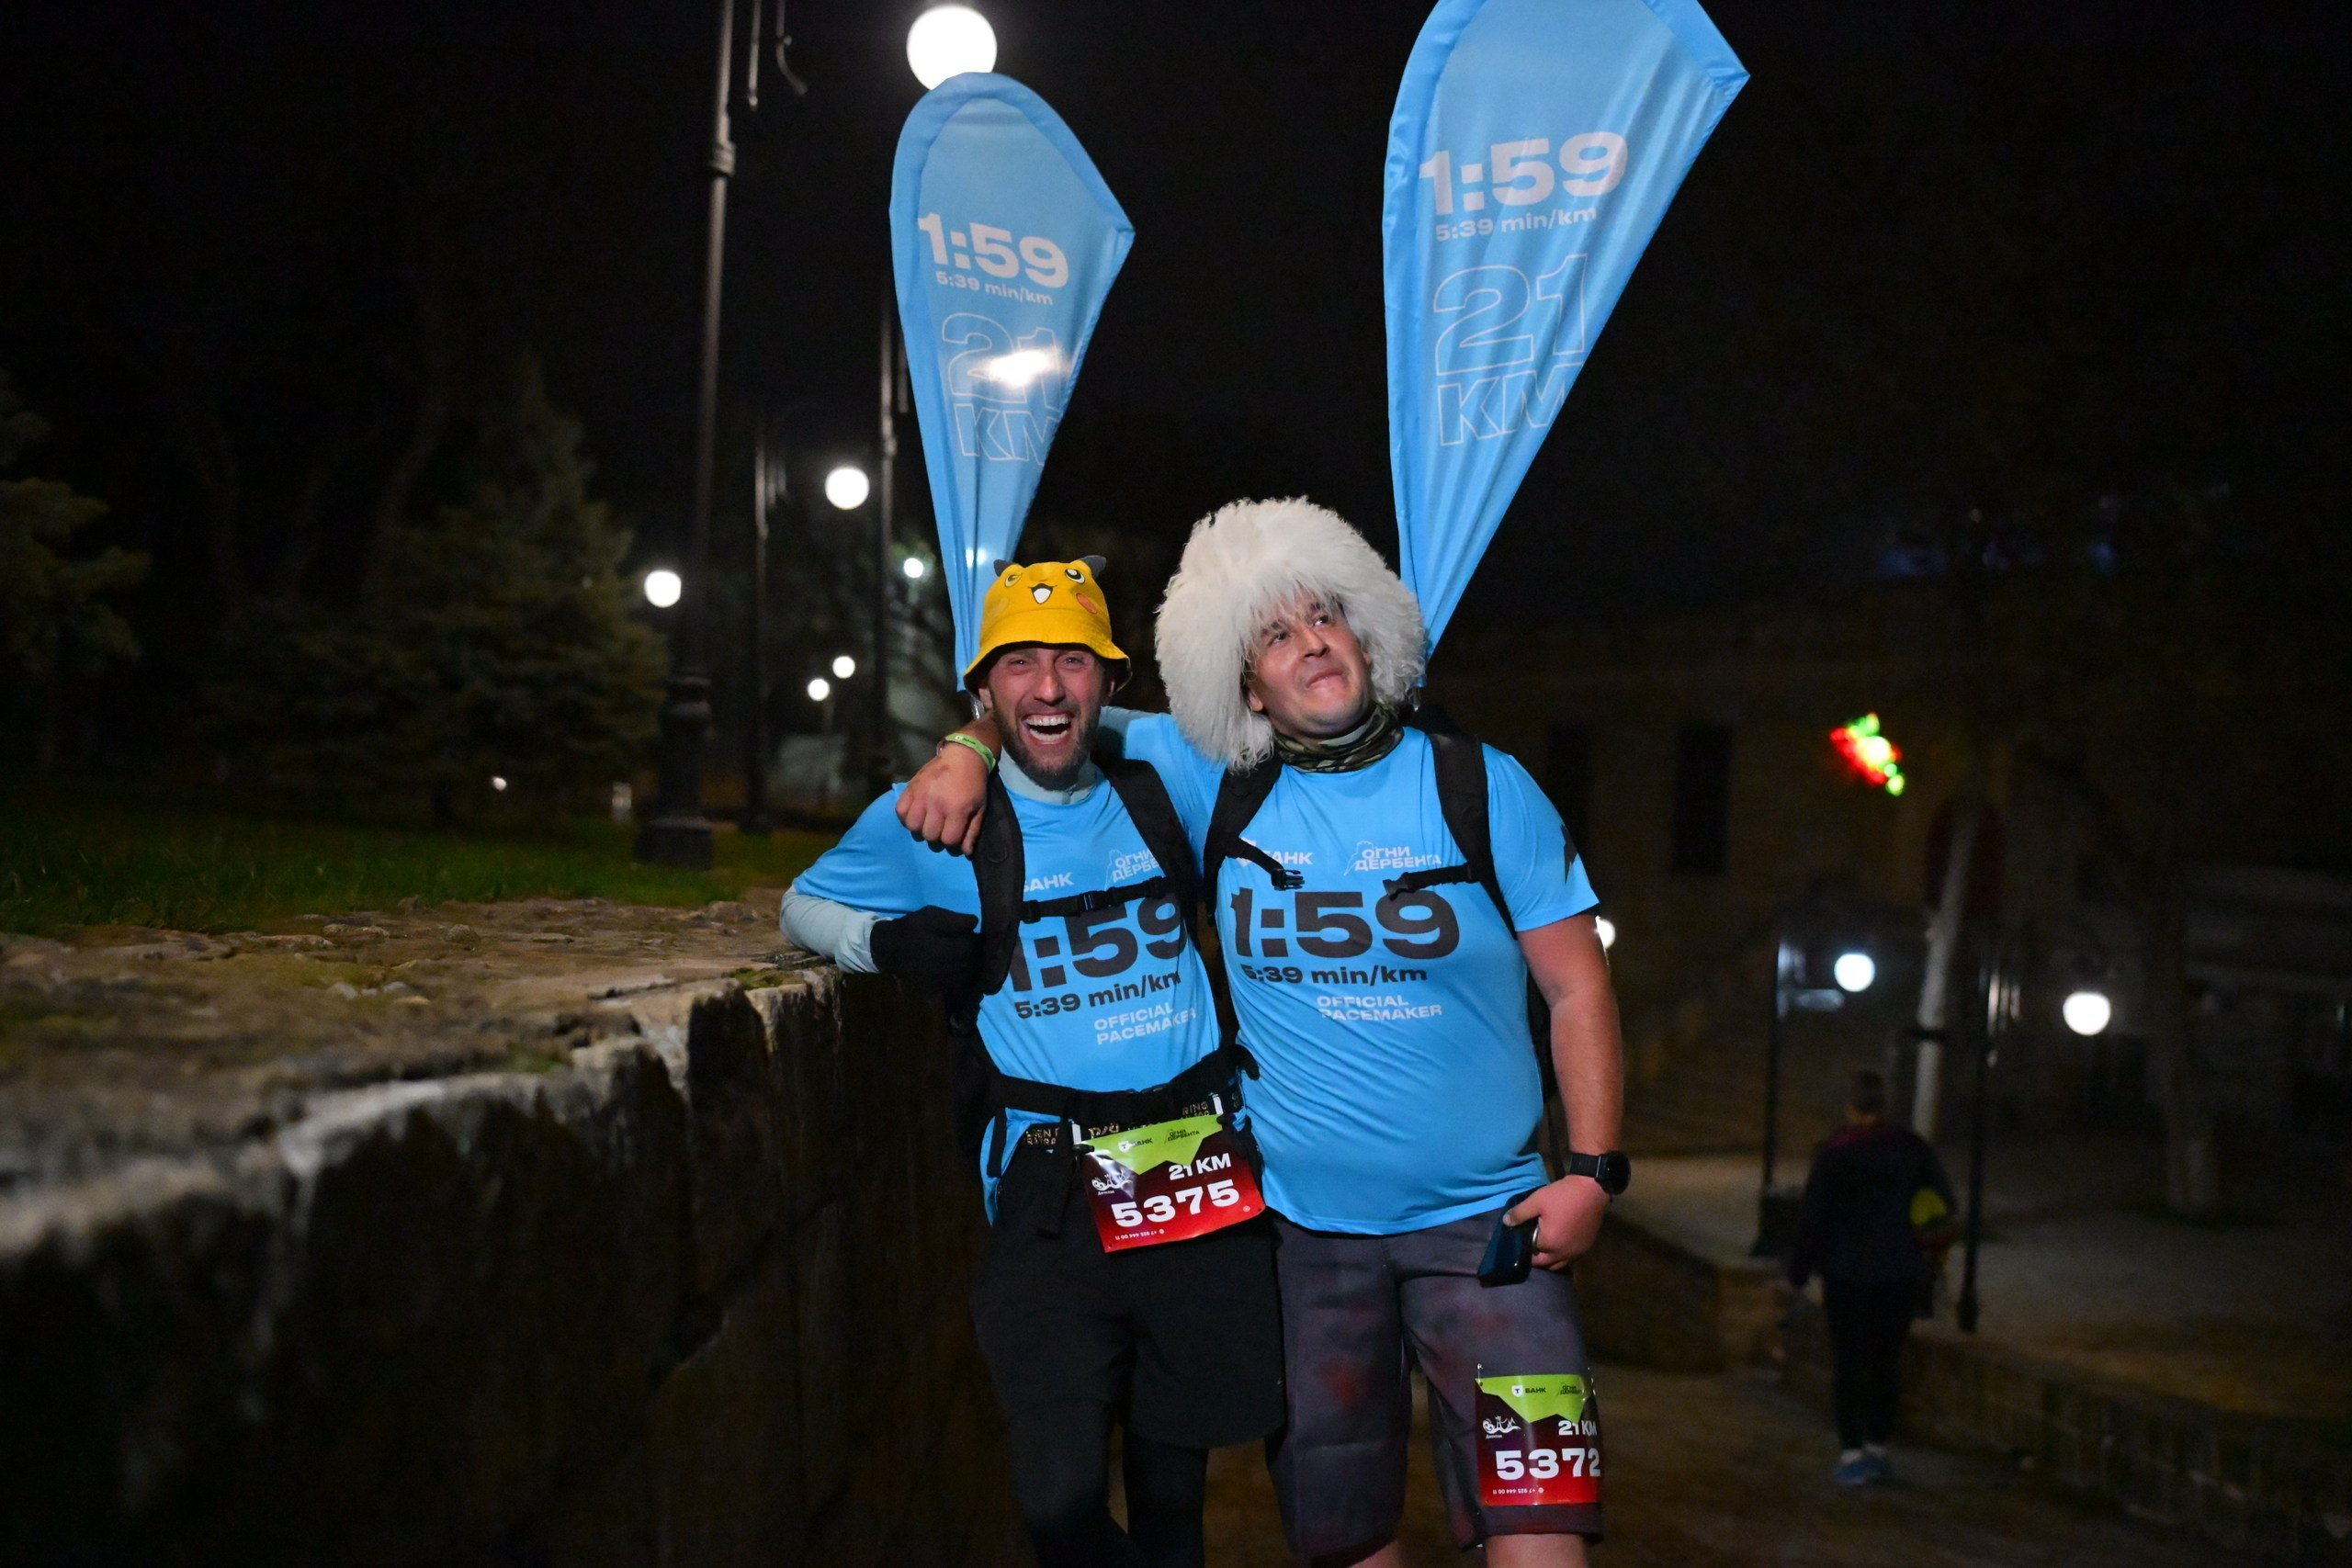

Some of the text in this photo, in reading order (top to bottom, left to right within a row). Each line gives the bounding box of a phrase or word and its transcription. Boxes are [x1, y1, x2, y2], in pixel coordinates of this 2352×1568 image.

[1419, 131, 1628, 216] 1:59
[1436, 207, 1598, 242] 5:39 min/km
[917, 212, 1069, 288] 1:59
[935, 270, 1054, 306] 5:39 min/km
[1433, 253, 1589, 377] 21
[942, 312, 1063, 412] 21
[1114, 849, 1154, 869] ОГНИ
[1262, 850, 1314, 865] АНК
[1362, 845, 1411, 860] ОГНИ
[1112, 859, 1160, 883] ДЕРБЕ
[1230, 886, 1460, 960] 1:59
[1241, 964, 1428, 987] 5:39 min/km
[1014, 993, 1081, 1020] 5:39
[1316, 994, 1409, 1009] OFFICIAL
[1320, 1004, 1443, 1021] PACEMAKER
[1093, 1002, 1175, 1031] OFFICIAL
[1169, 1152, 1232, 1181] 21 KM
[1111, 1179, 1240, 1228] 5375
[1557, 1419, 1598, 1437] 21 KM
[1495, 1447, 1601, 1481] 5372
